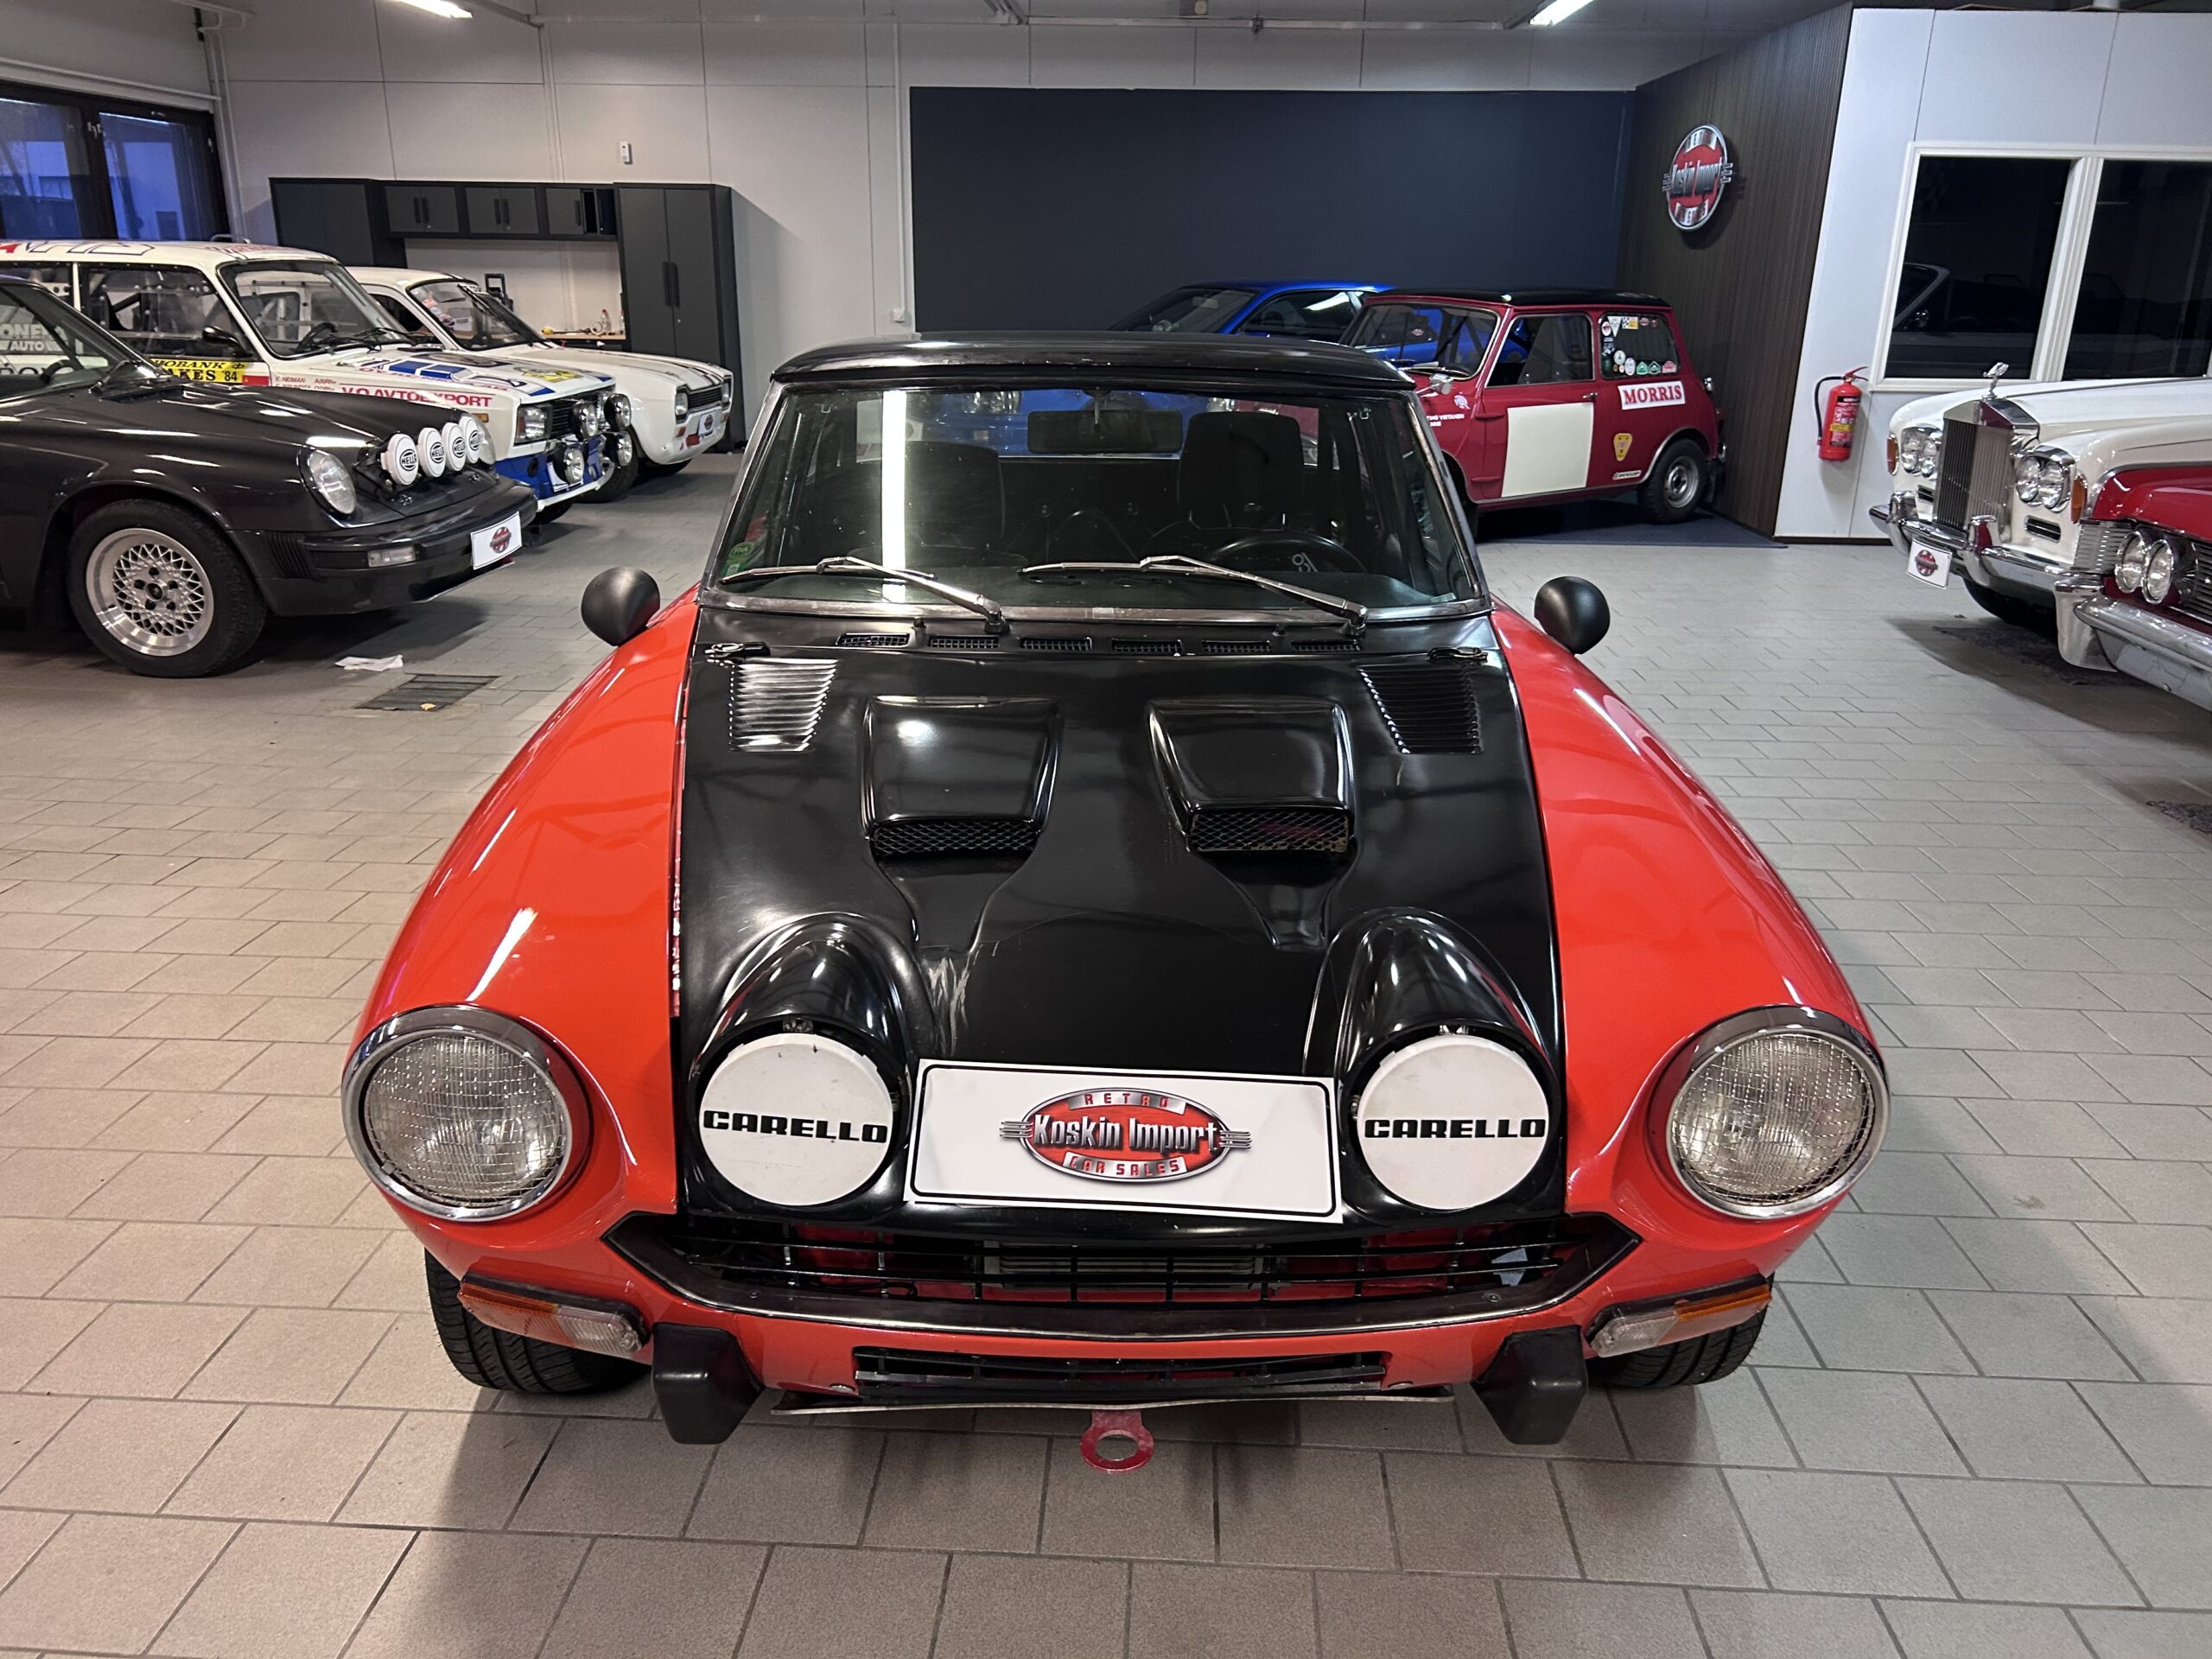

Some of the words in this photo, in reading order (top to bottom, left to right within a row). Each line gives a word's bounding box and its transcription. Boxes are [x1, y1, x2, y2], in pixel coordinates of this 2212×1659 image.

[1623, 385, 1682, 404] MORRIS
[1084, 1093, 1169, 1108] RETRO
[703, 1110, 888, 1143] CARELLO
[1034, 1115, 1121, 1147] Koskin
[1128, 1117, 1217, 1154] Import
[1364, 1119, 1546, 1138] CARELLO
[1070, 1156, 1105, 1173] CAR
[1116, 1160, 1179, 1176] SALES
